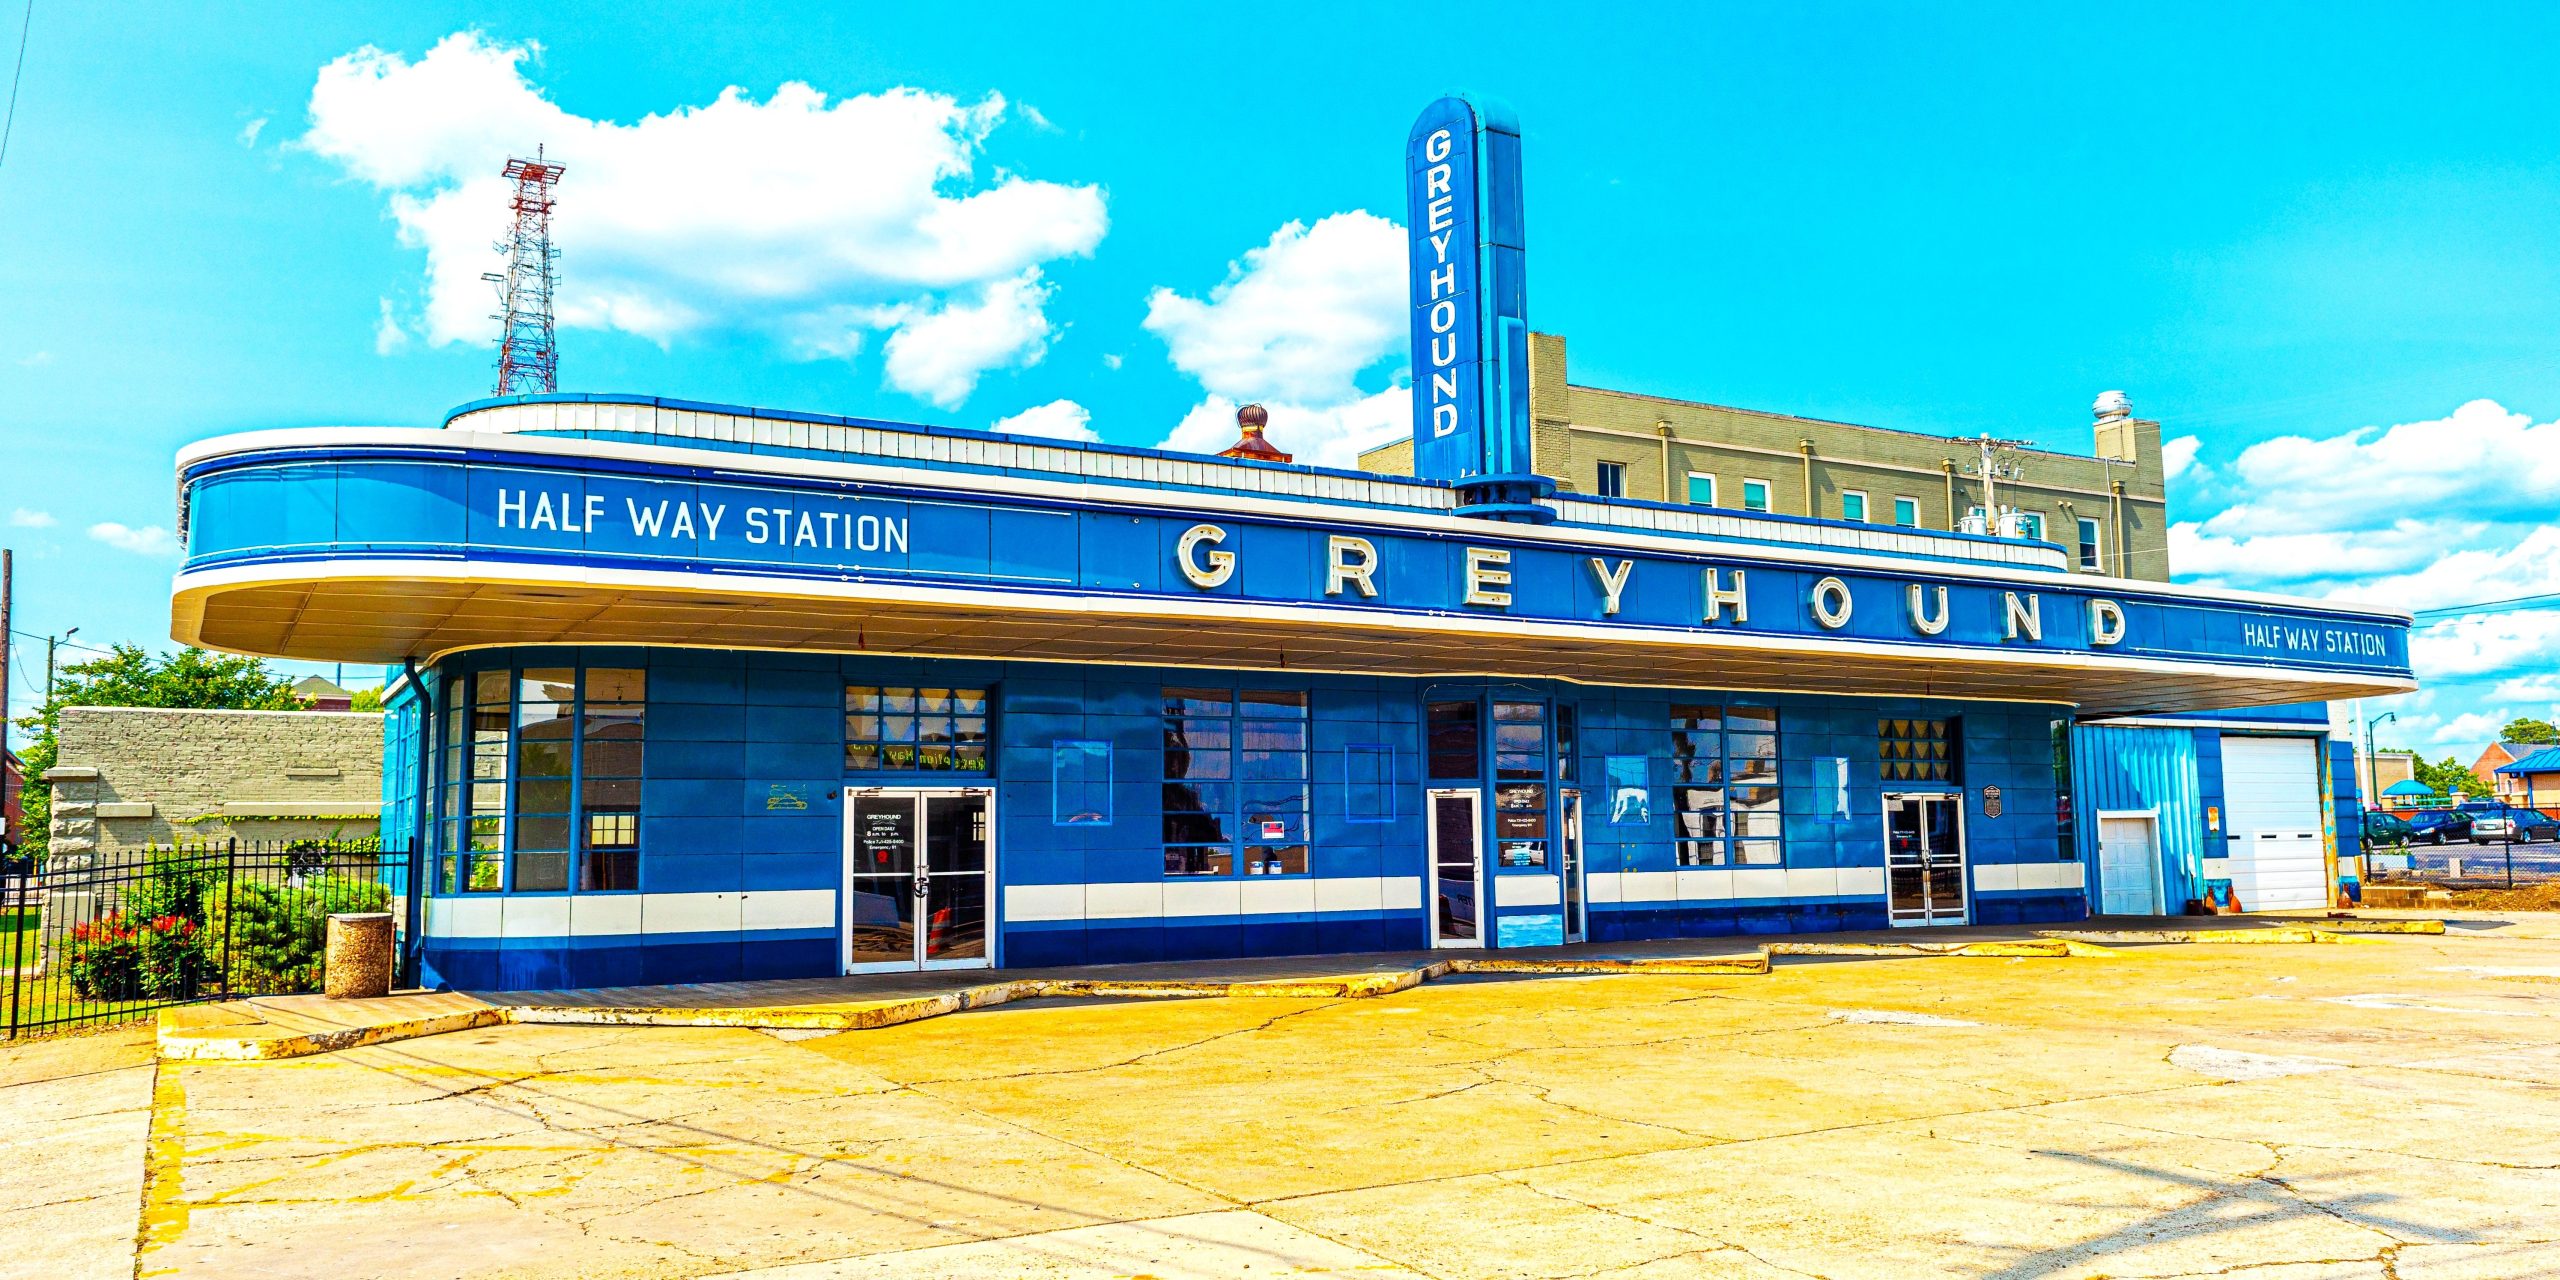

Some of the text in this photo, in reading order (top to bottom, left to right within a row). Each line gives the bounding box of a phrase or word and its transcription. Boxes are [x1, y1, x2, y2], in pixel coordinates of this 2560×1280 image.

[1425, 128, 1458, 439] GREYHOUND
[497, 487, 909, 554] HALF WAY STATION
[1177, 523, 2126, 646] GREYHOUND
[2244, 622, 2386, 657] HALF WAY STATION
